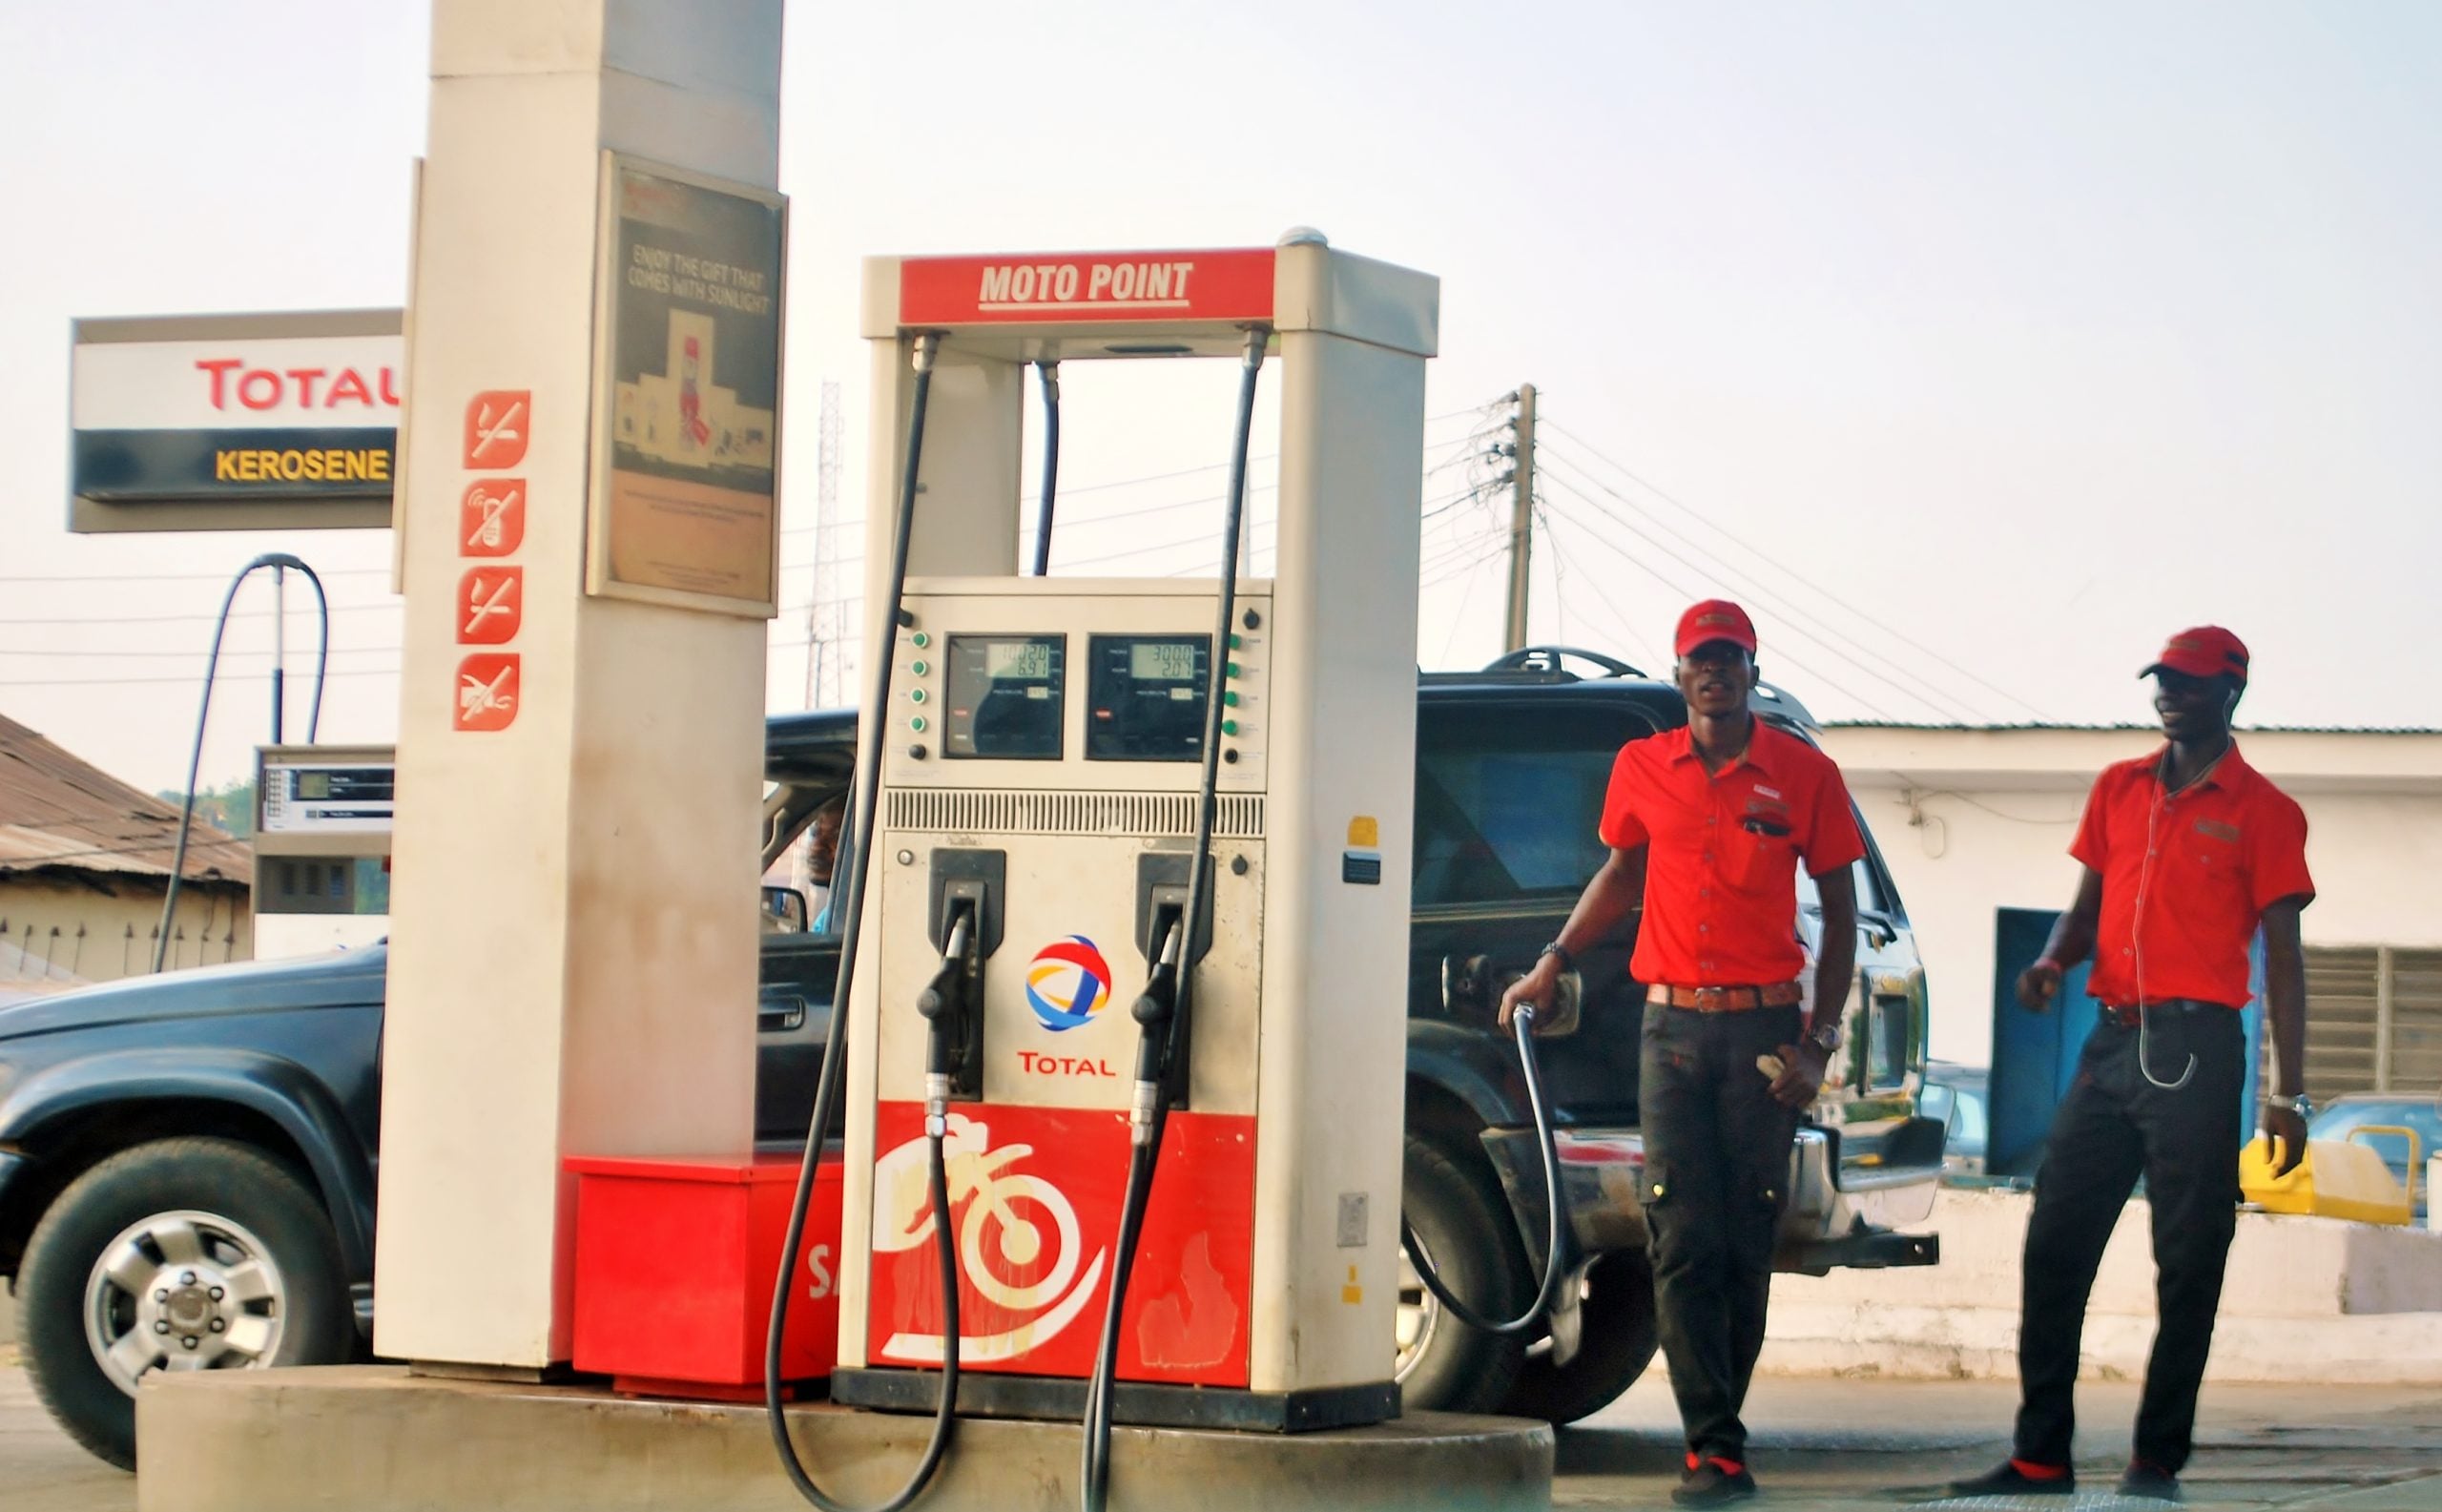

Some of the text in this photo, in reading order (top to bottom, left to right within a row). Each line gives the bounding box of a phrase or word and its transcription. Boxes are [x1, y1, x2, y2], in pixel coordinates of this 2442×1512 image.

[628, 265, 670, 295] COMES
[672, 274, 705, 301] WITH
[673, 253, 698, 278] THE
[701, 259, 729, 284] GIFT
[731, 267, 764, 291] THAT
[979, 261, 1193, 302] MOTO POINT
[195, 359, 400, 411] TOTAL
[216, 448, 390, 482] KEROSENE
[1016, 1051, 1116, 1077] TOTAL
